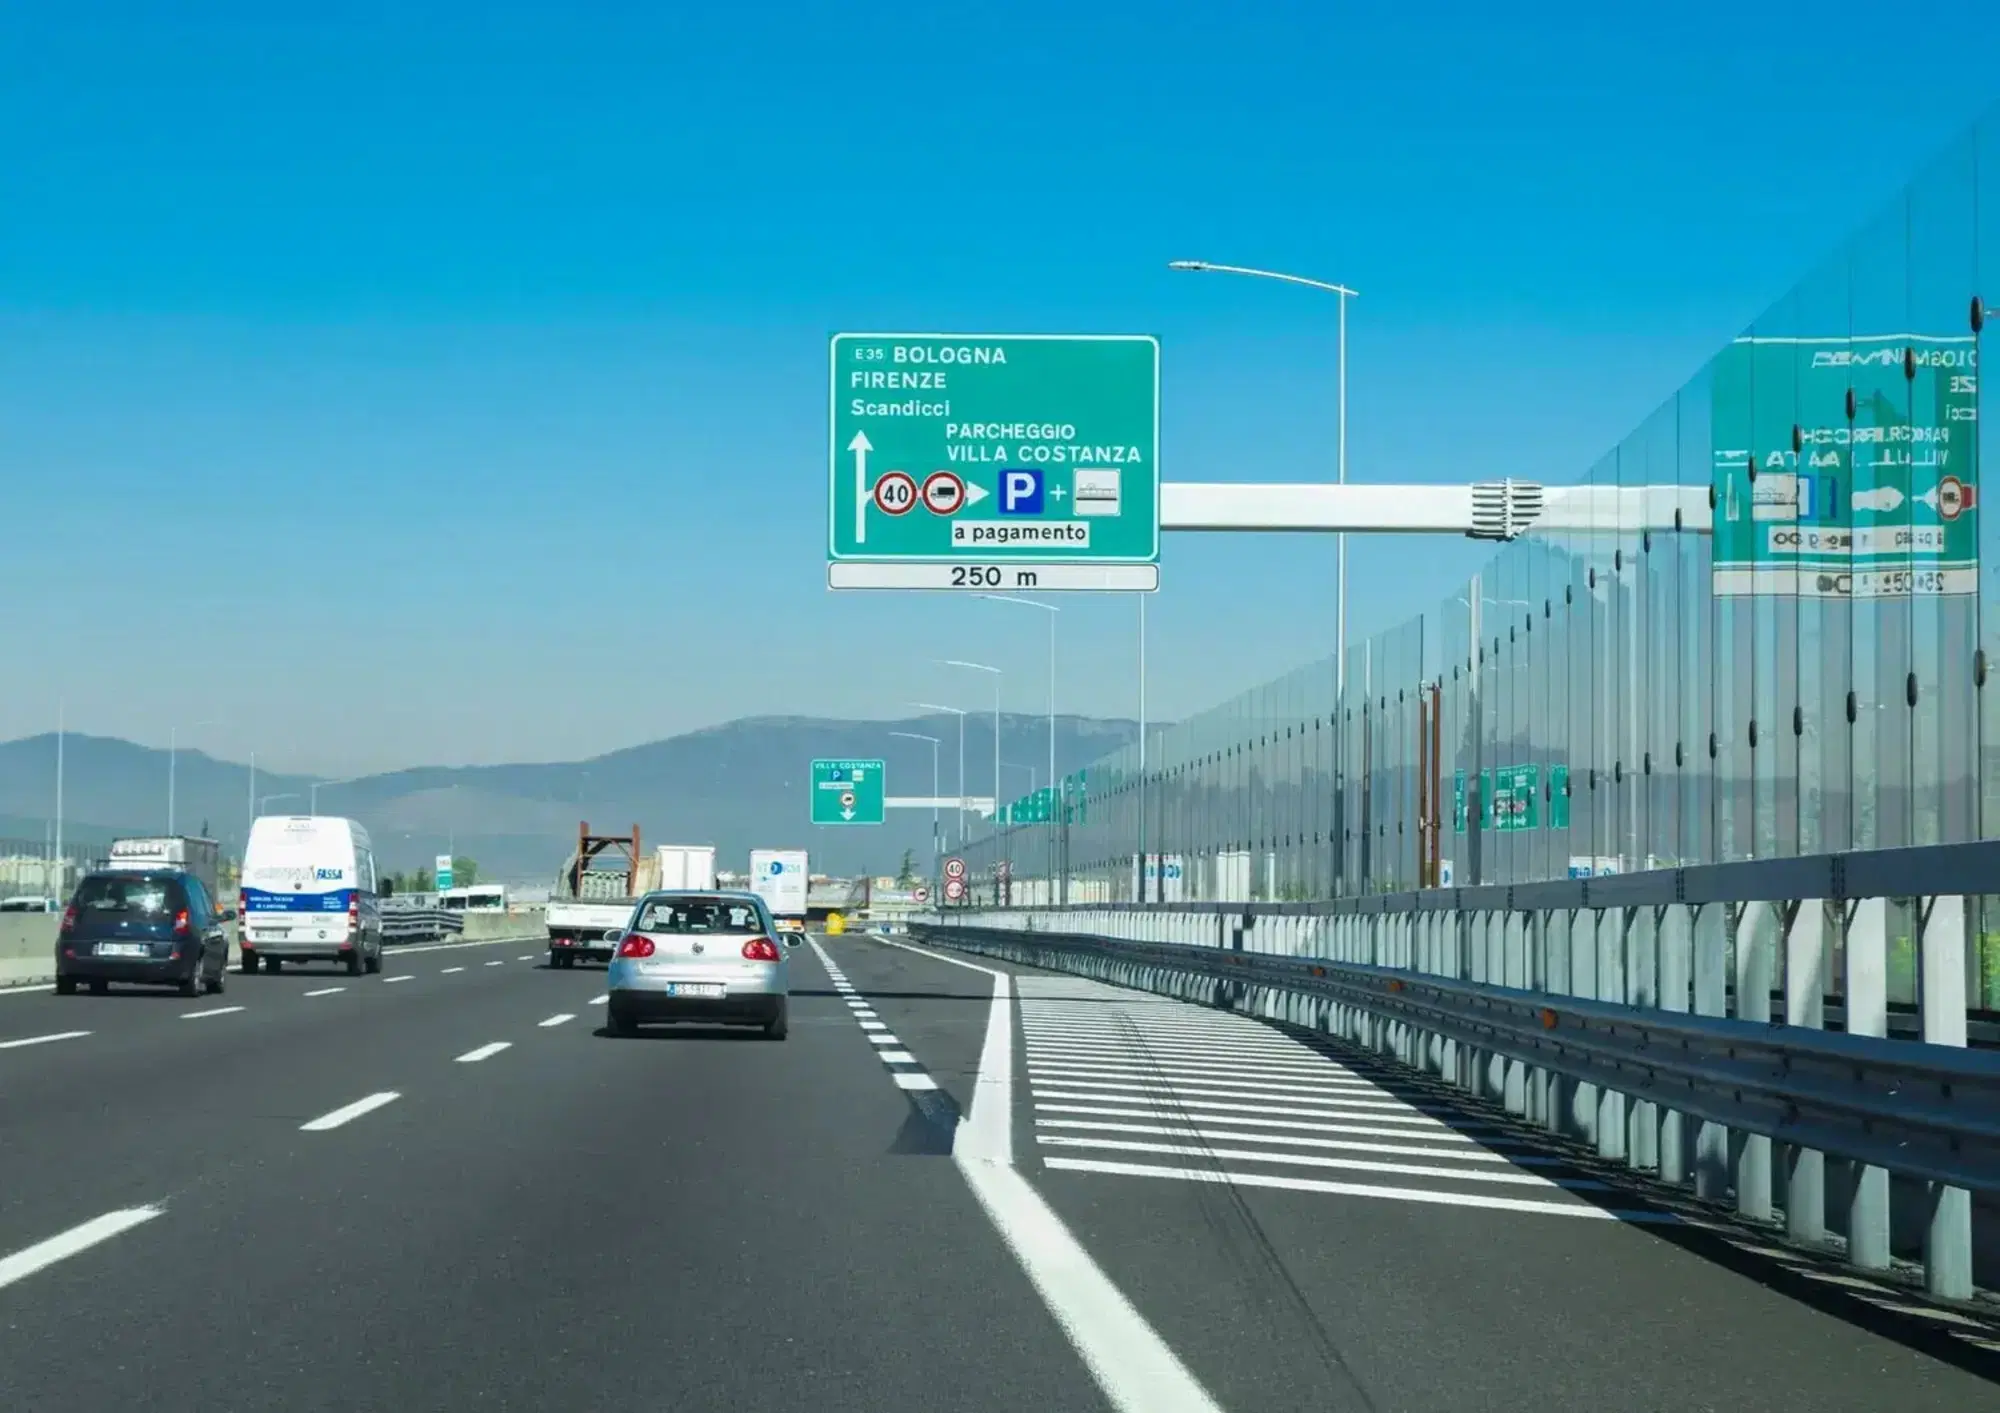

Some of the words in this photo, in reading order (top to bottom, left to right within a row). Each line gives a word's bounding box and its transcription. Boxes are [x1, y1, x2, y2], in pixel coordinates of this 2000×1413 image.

[894, 347, 1006, 364] BOLOGNA
[851, 372, 947, 389] FIRENZE
[851, 399, 950, 417] Scandicci
[946, 424, 1076, 440] PARCHEGGIO
[947, 446, 1008, 462] VILLA
[1018, 446, 1141, 463] COSTANZA
[883, 485, 909, 504] 40
[1006, 473, 1036, 510] P
[954, 527, 965, 540] a
[972, 524, 1086, 544] pagamento
[950, 566, 1002, 587] 250
[1017, 571, 1037, 586] m
[316, 868, 343, 881] FASSA
[949, 864, 961, 874] 40
